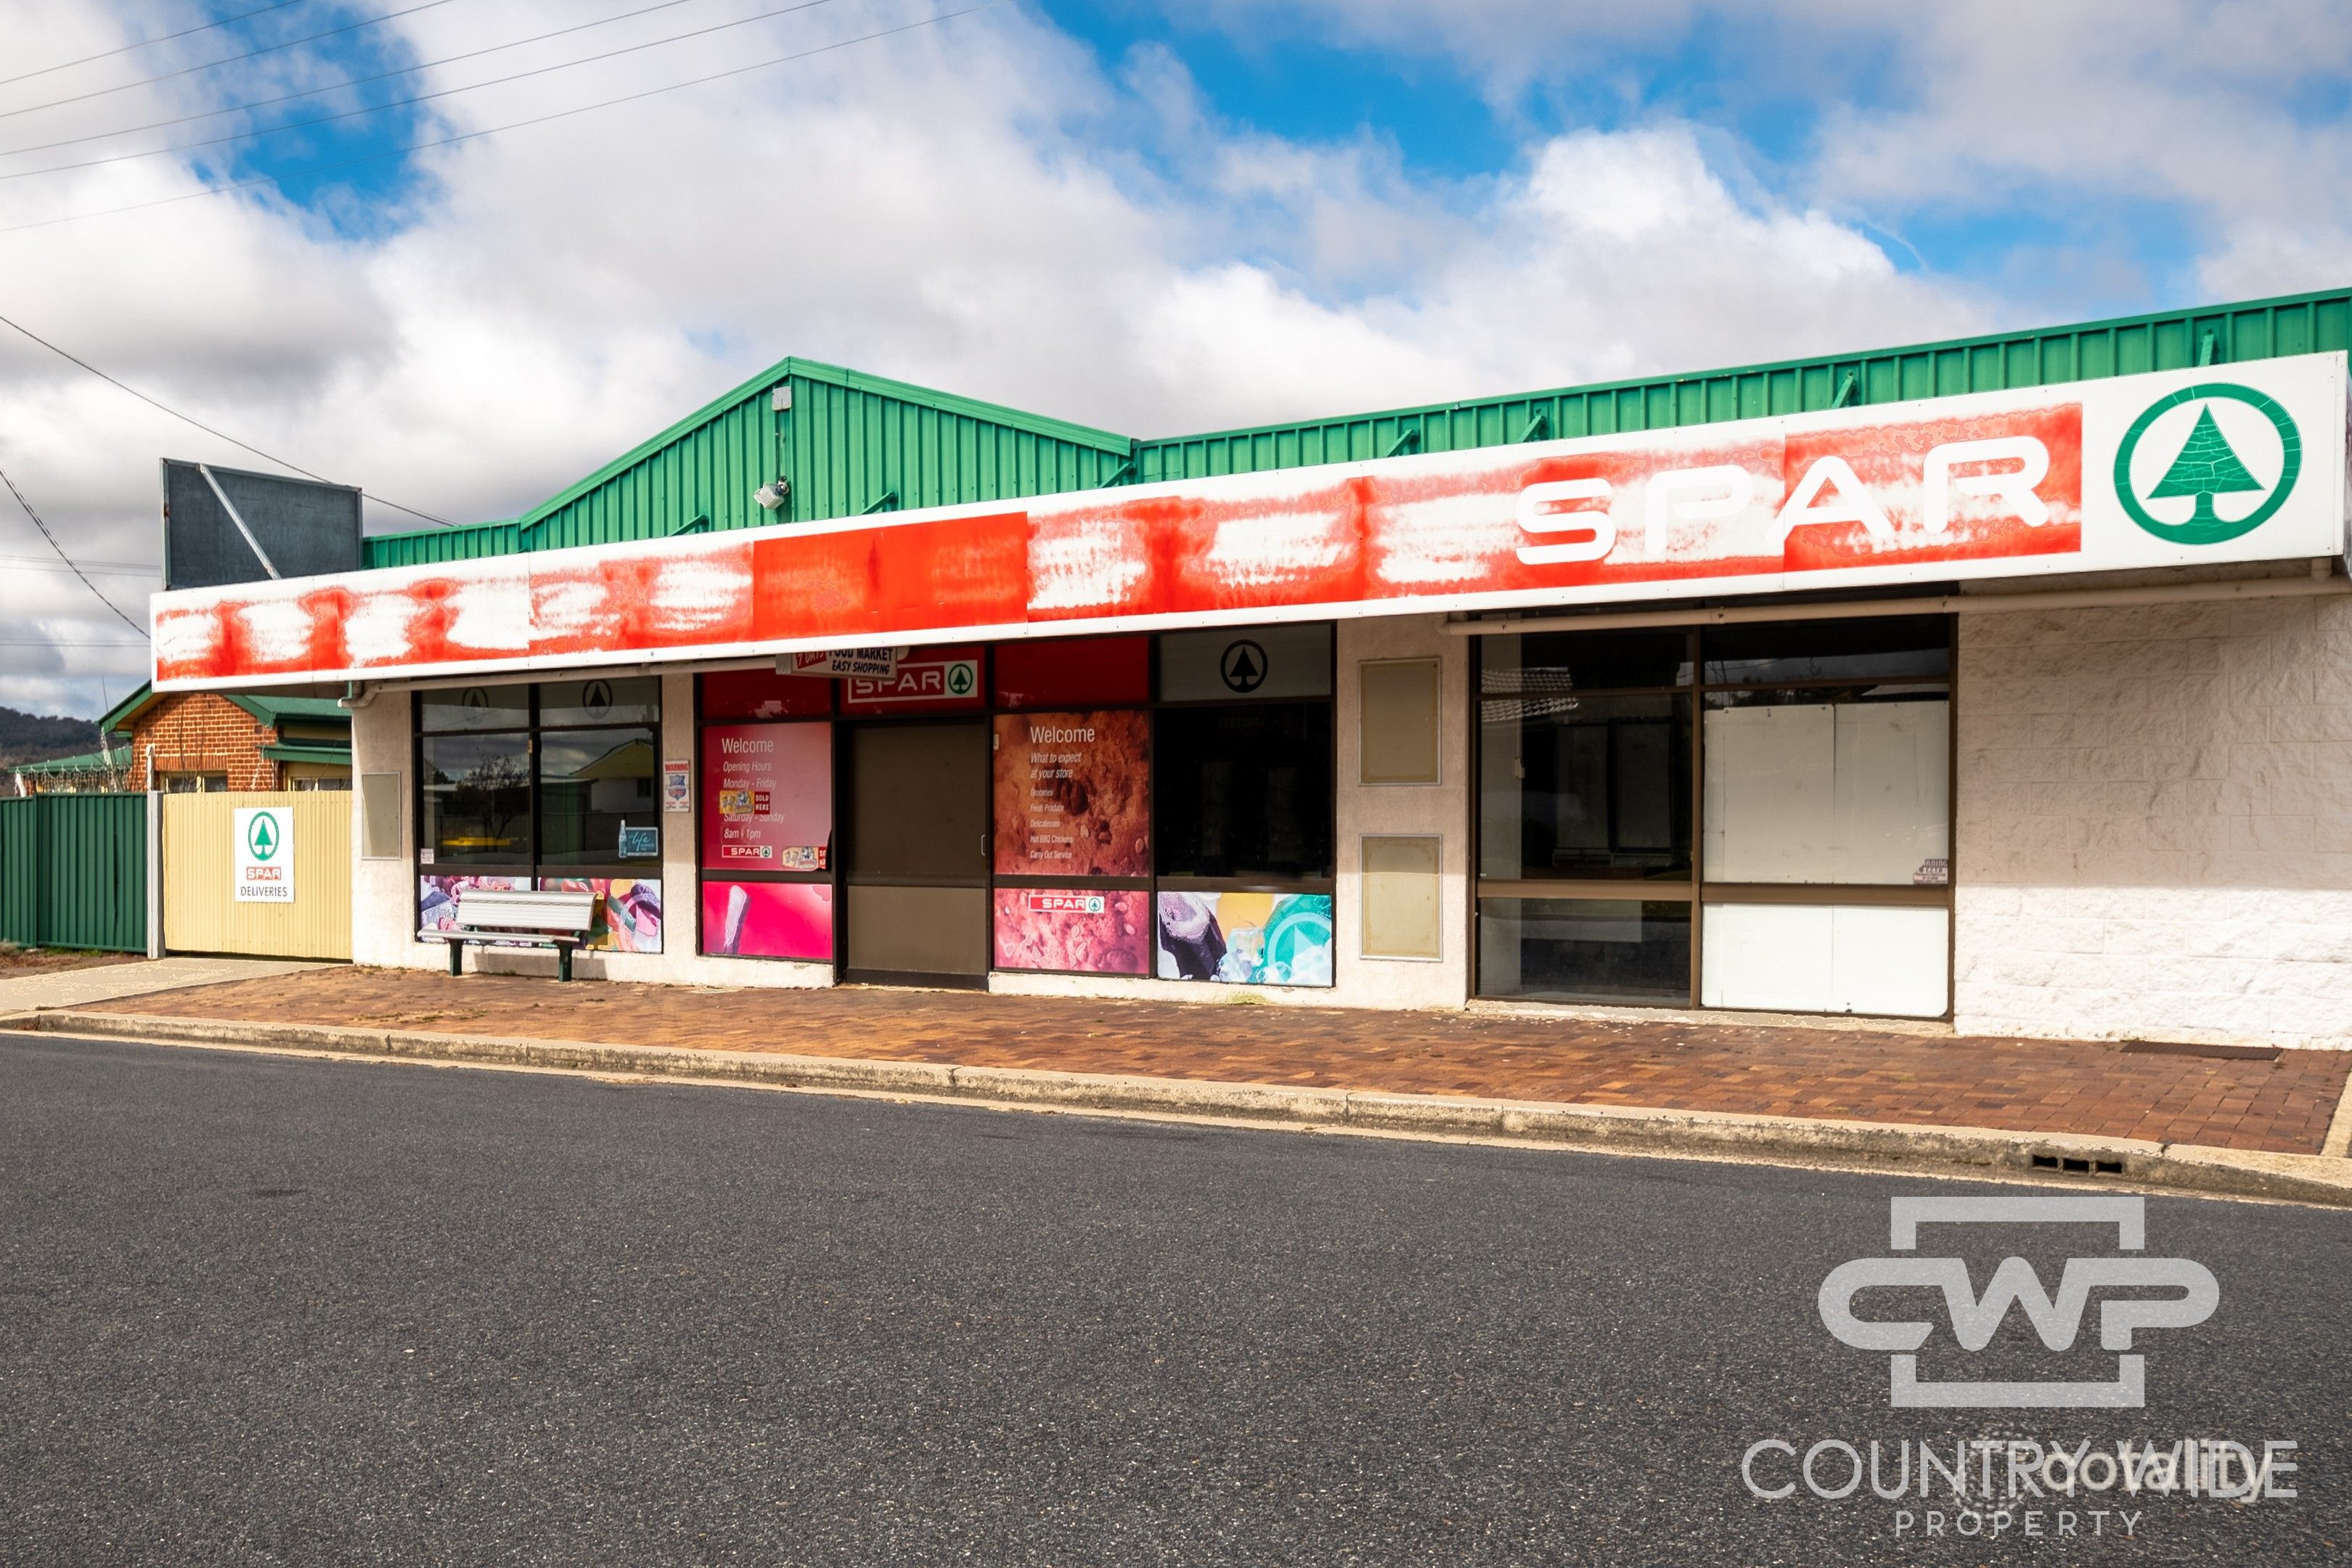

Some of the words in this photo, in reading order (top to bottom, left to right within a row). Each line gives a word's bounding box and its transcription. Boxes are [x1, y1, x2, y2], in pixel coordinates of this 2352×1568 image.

[1515, 435, 2049, 565] SPAR
[798, 653, 802, 666] 7
[857, 648, 893, 661] MARKET
[832, 660, 852, 671] EASY
[853, 661, 890, 674] SHOPPING
[856, 671, 941, 694] SPAR
[1031, 726, 1095, 743] Welcome
[722, 738, 774, 754] Welcome
[1031, 752, 1049, 764] What
[1050, 753, 1057, 763] to
[1058, 752, 1082, 764] expect
[723, 761, 751, 774] Opening
[751, 761, 772, 772] Hours
[1031, 769, 1037, 779] at
[1038, 769, 1055, 780] your
[1055, 768, 1074, 778] store
[723, 777, 751, 791] Monday
[756, 777, 777, 791] Friday
[1045, 803, 1064, 812] Produce
[724, 812, 754, 824] Saturday
[759, 812, 785, 824] Sunday
[746, 829, 761, 841] 1pm
[731, 847, 760, 856] SPAR
[1030, 850, 1044, 860] Carry
[1044, 850, 1053, 859] Out
[1053, 850, 1072, 859] Service
[248, 868, 280, 879] SPAR
[240, 886, 287, 897] DELIVERIES
[1042, 898, 1085, 909] SPAR
